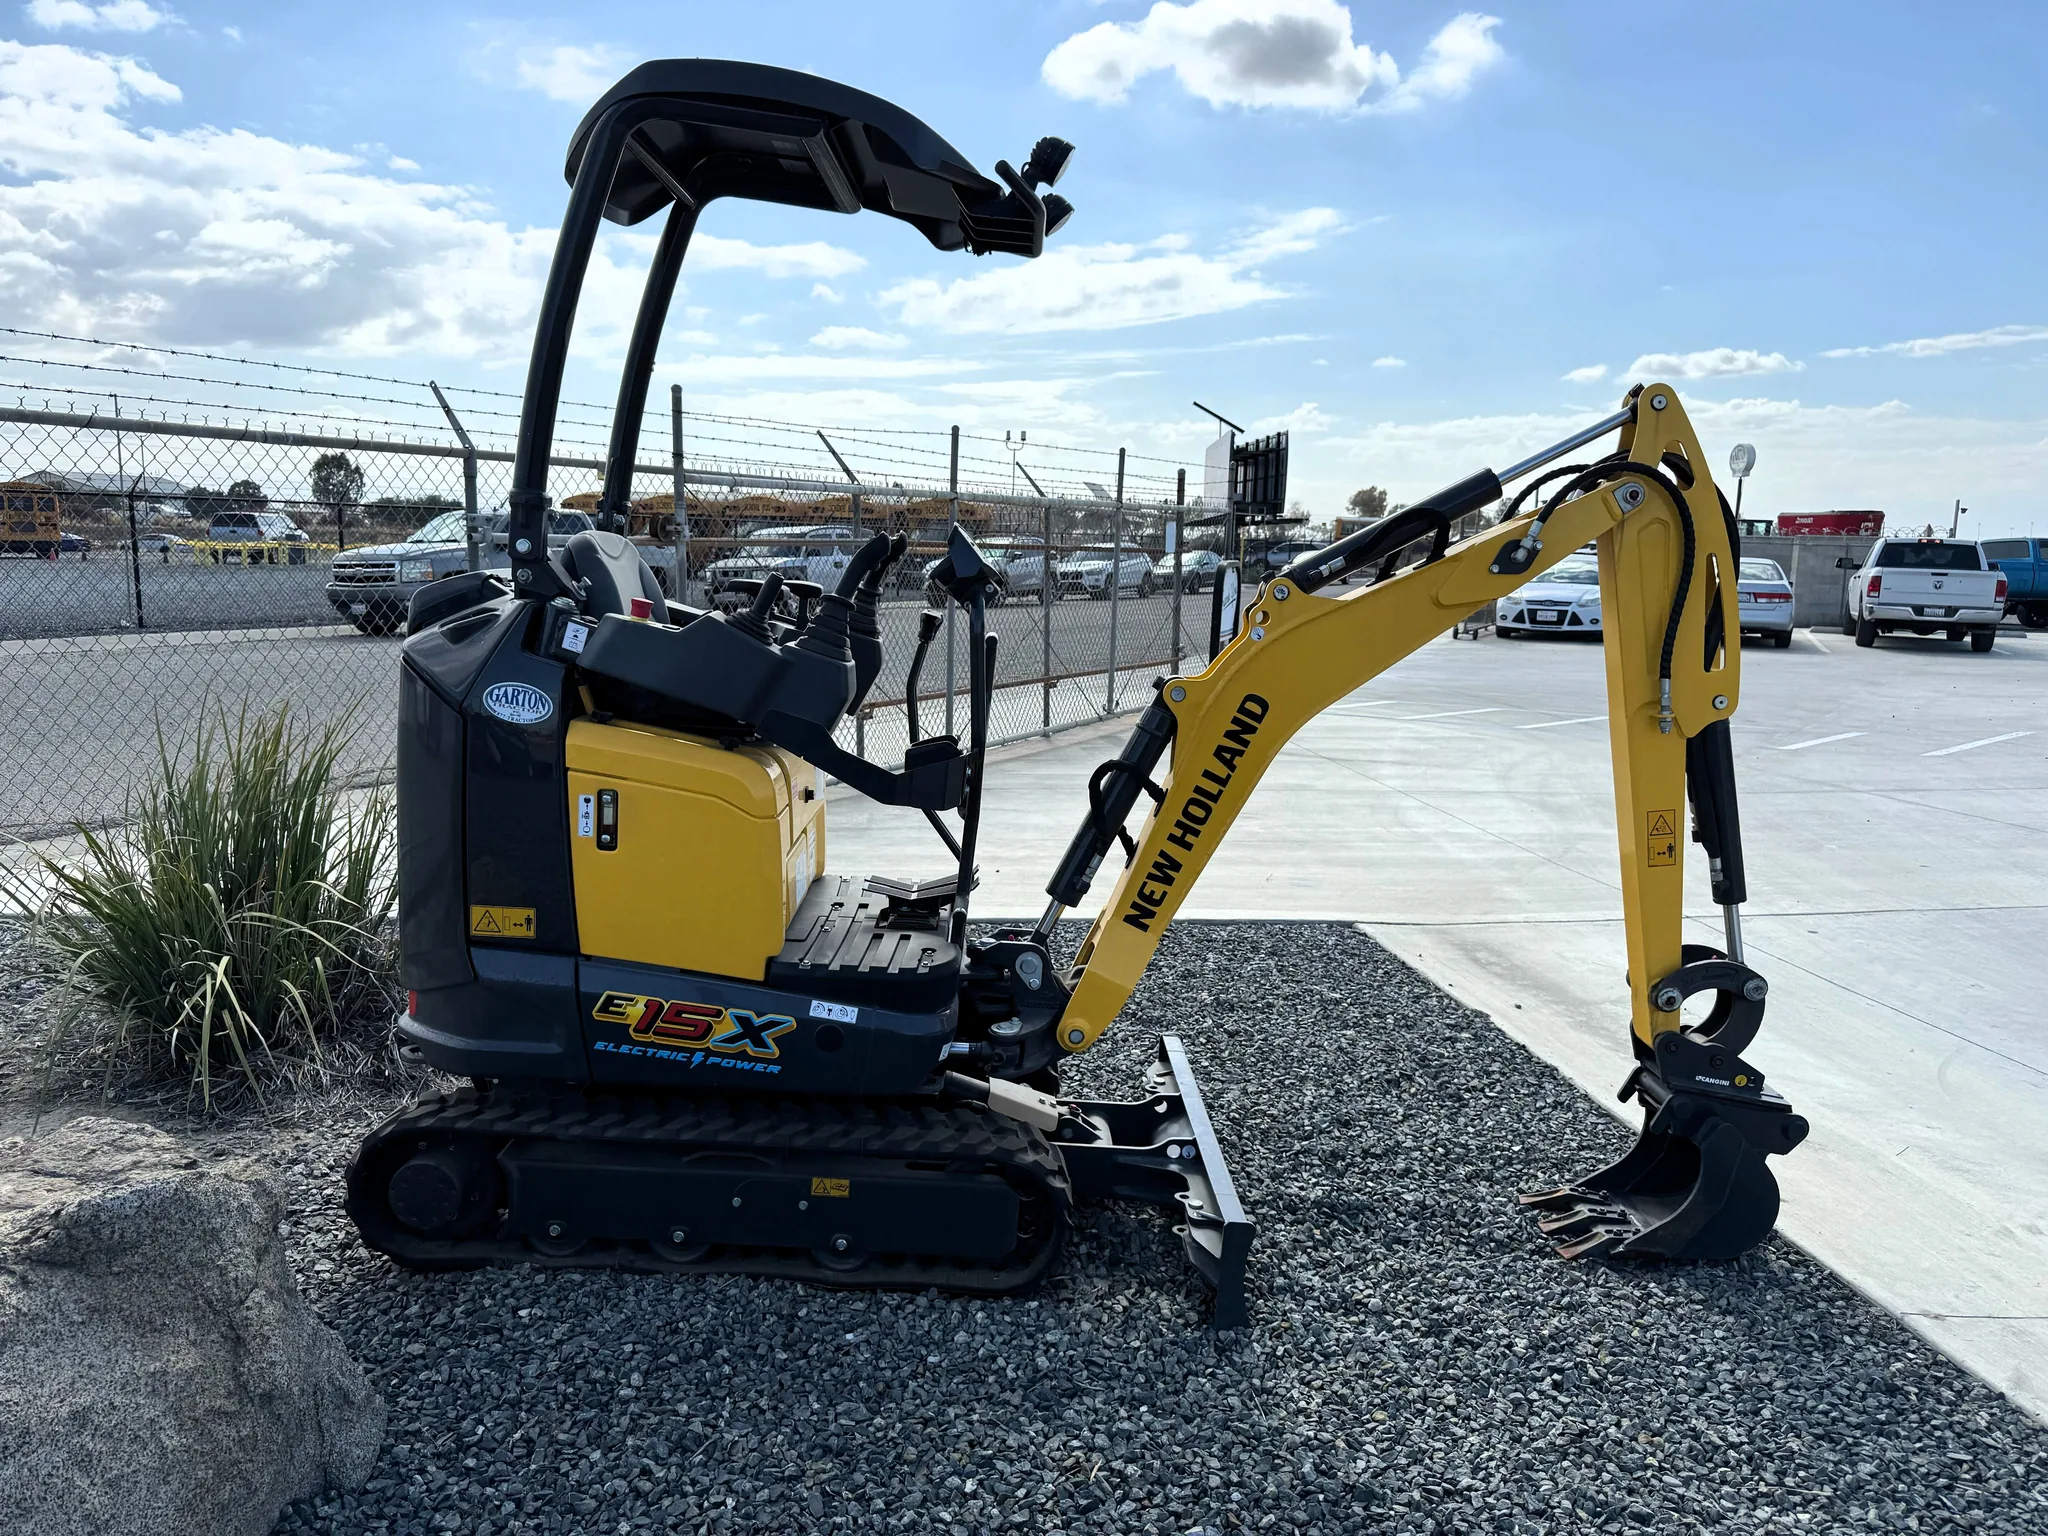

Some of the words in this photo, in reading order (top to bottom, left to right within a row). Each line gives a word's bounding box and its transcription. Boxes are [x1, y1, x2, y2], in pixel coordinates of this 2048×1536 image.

[489, 687, 546, 711] GARTON
[492, 701, 543, 715] TRACTOR
[1122, 848, 1184, 933] NEW
[1166, 693, 1270, 852] HOLLAND
[592, 990, 797, 1059] E15X
[593, 1041, 690, 1062] ELECTRIC
[706, 1057, 782, 1075] POWER
[1700, 1076, 1730, 1087] CANGINI
